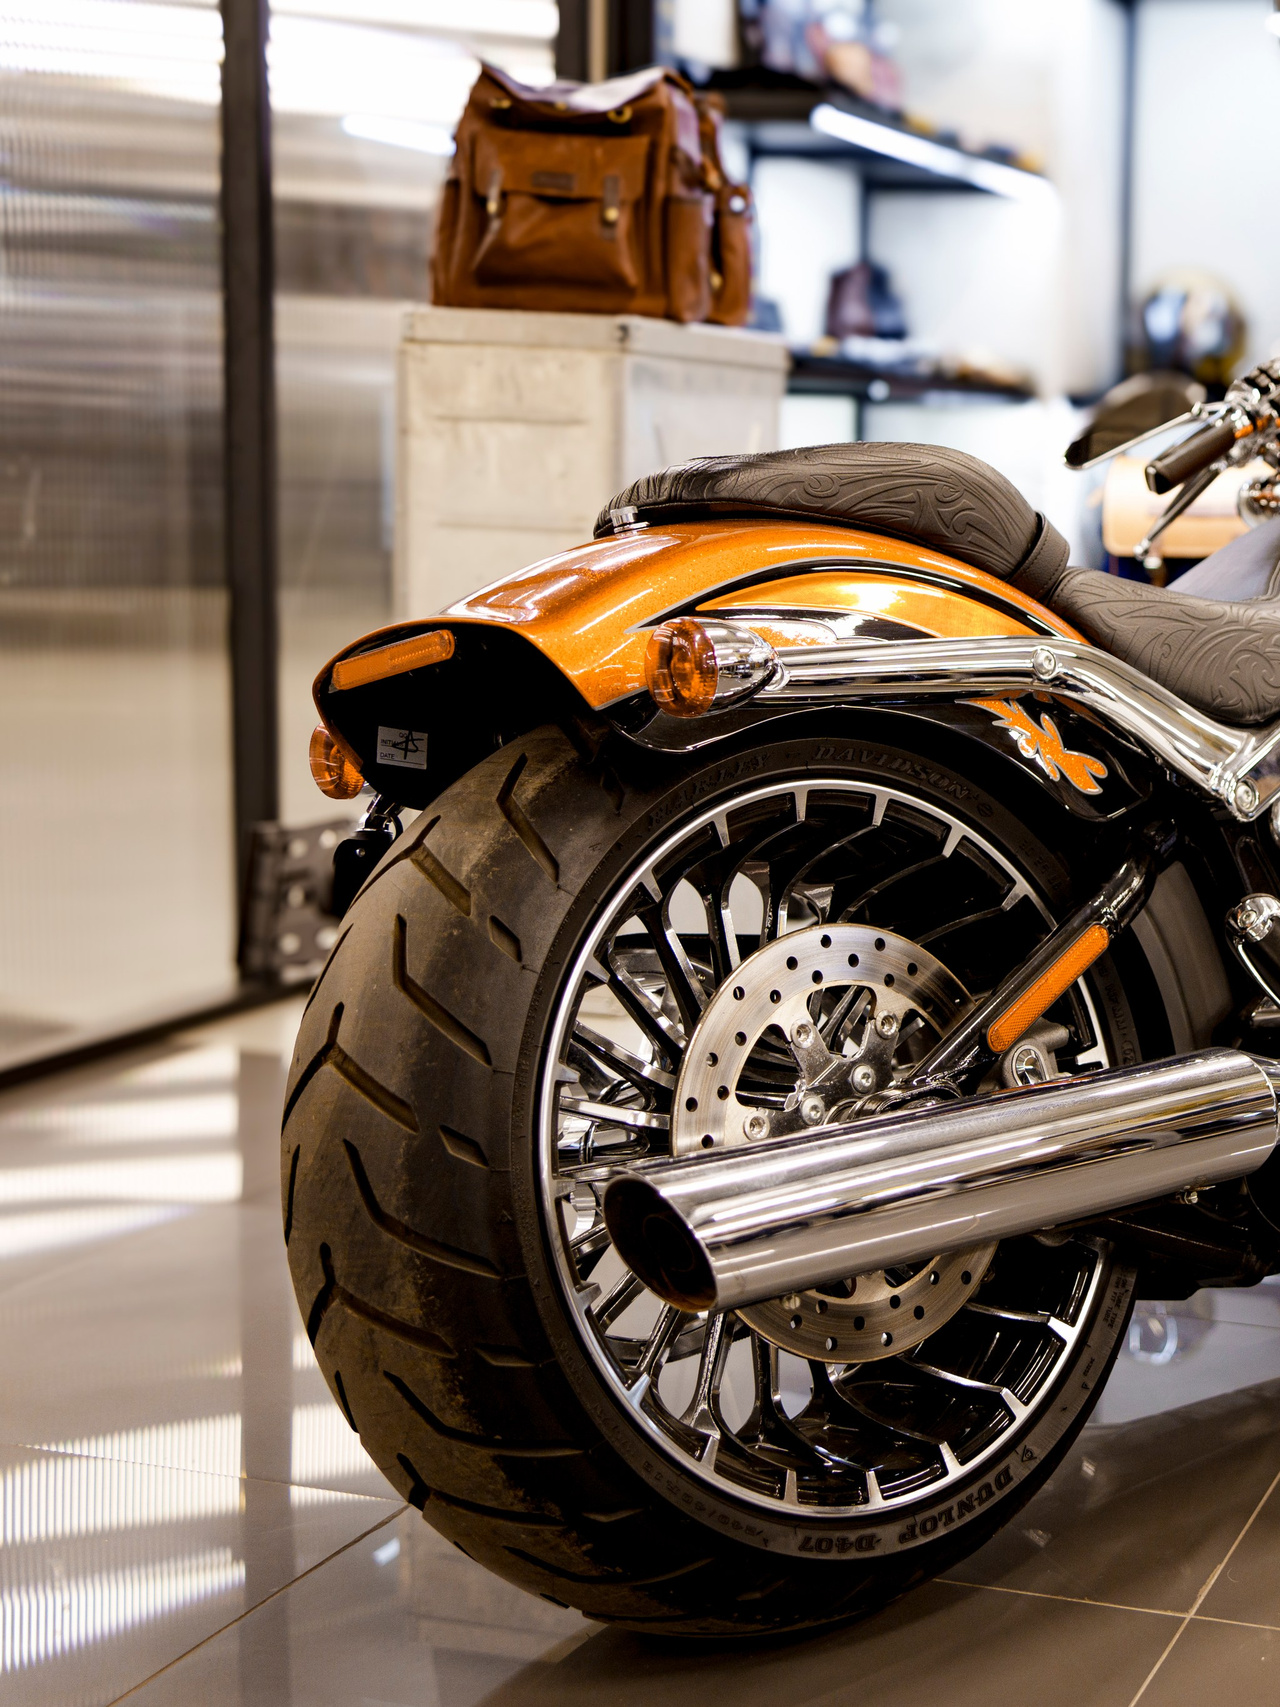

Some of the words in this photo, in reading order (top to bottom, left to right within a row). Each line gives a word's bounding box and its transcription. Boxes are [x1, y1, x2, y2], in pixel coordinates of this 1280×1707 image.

[379, 752, 395, 760] DATE
[813, 745, 970, 800] DAVIDSON
[899, 1465, 1014, 1543] DUNLOP
[799, 1533, 877, 1554] D407
